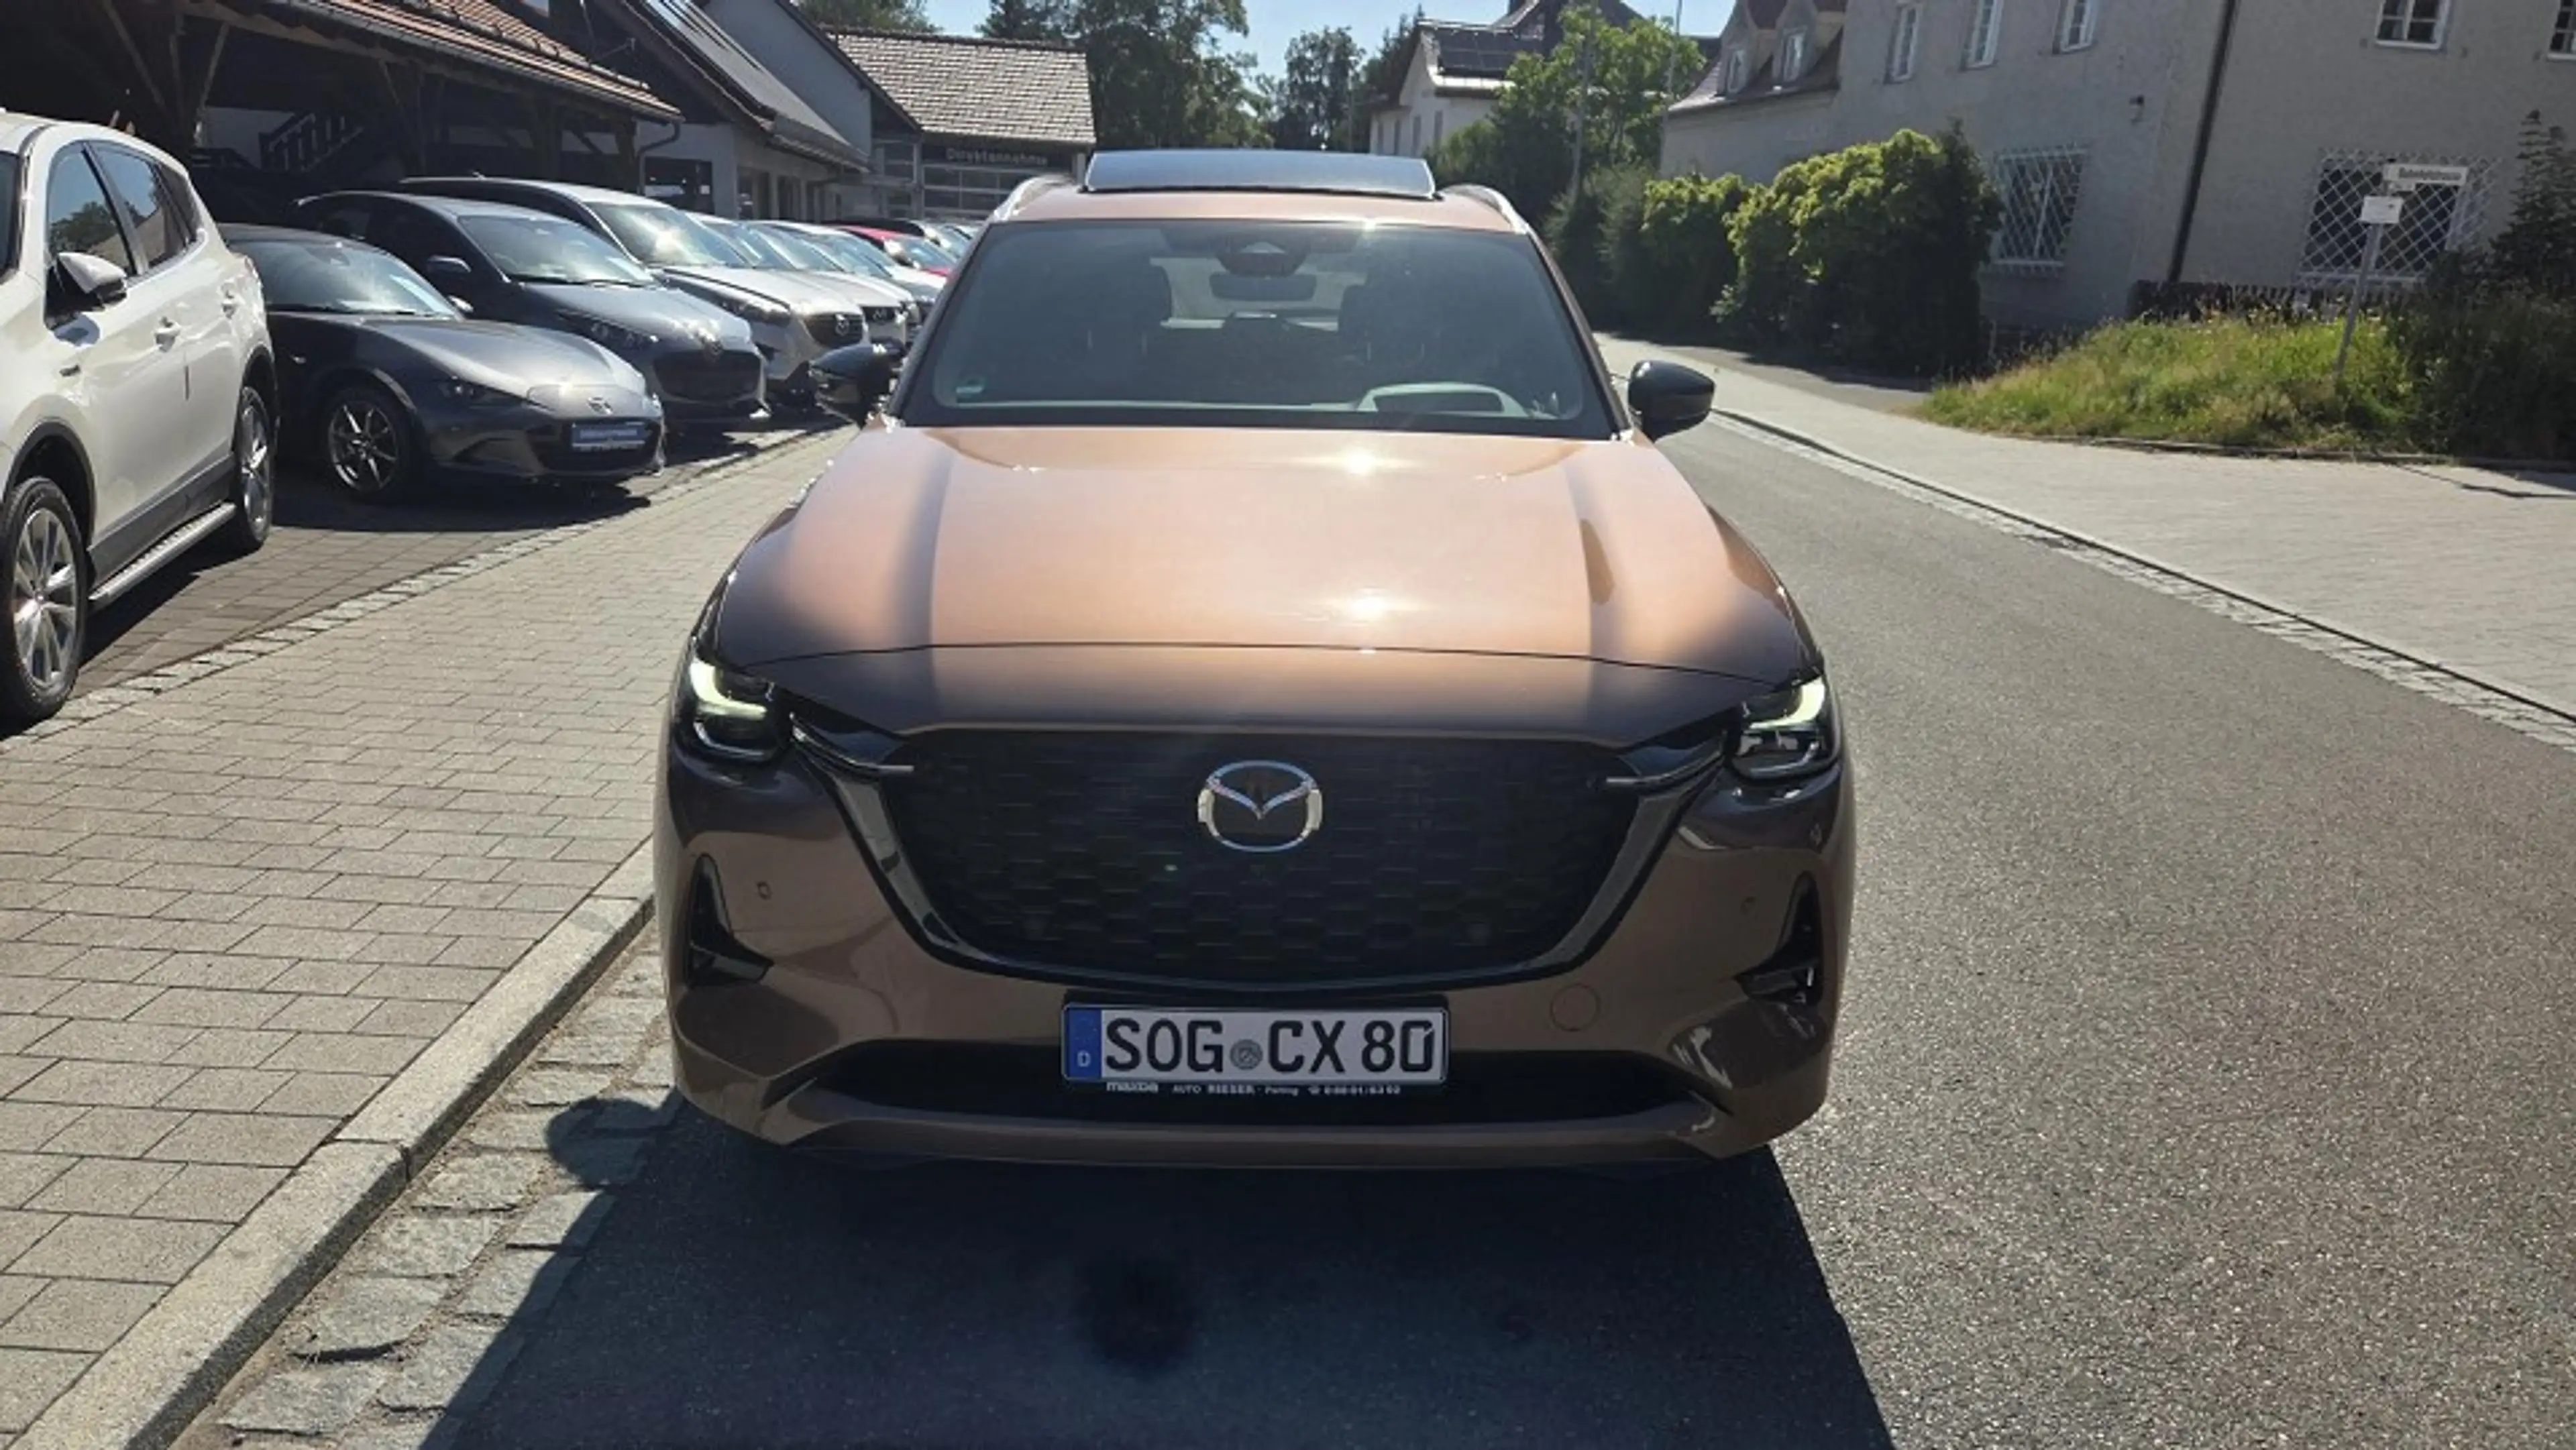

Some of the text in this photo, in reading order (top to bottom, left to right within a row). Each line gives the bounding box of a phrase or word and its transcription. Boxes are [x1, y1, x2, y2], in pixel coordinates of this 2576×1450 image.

[1077, 1050, 1091, 1067] D
[1106, 1017, 1434, 1073] SOG CX 80
